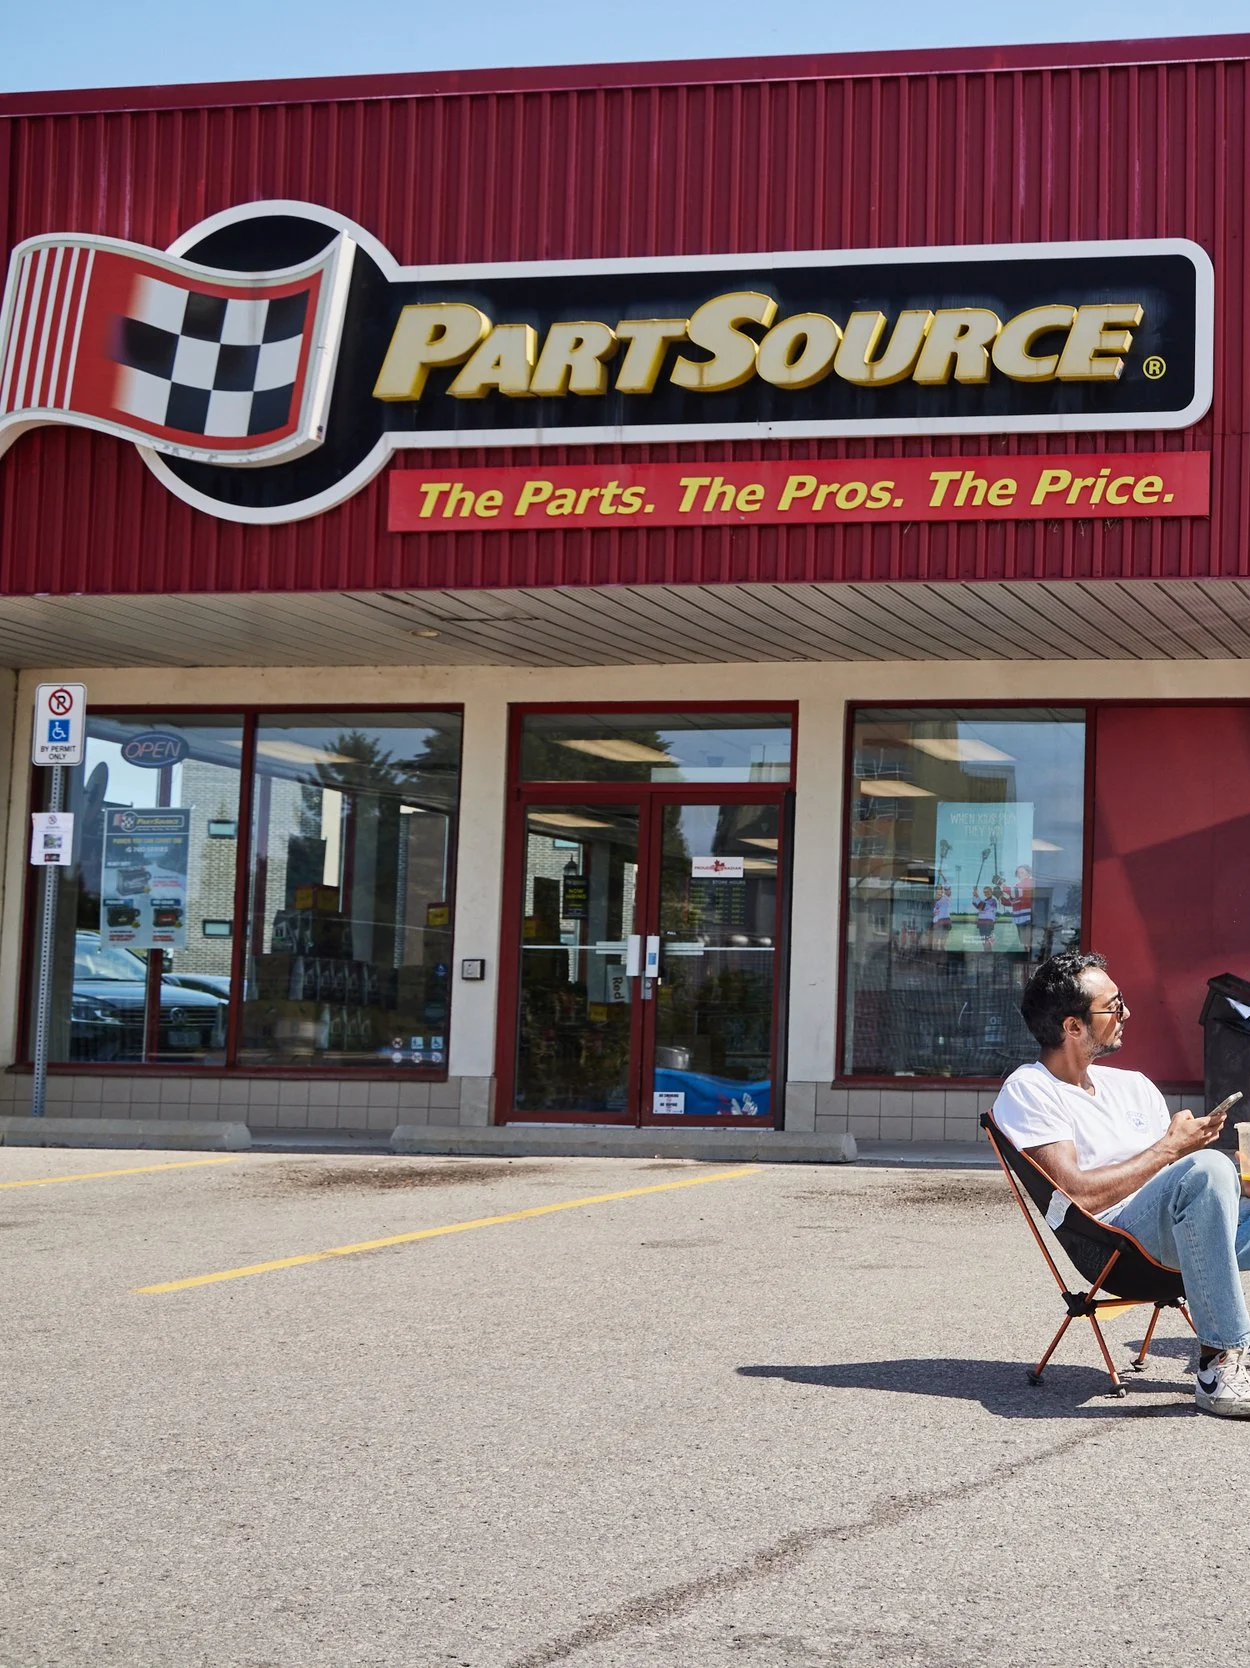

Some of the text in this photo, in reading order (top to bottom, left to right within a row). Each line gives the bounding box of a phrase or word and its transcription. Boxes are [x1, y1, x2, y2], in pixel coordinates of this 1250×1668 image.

[372, 291, 1145, 402] PARTSOURCE
[420, 469, 1173, 516] The Parts. The Pros. The Price.
[125, 742, 181, 758] OPEN
